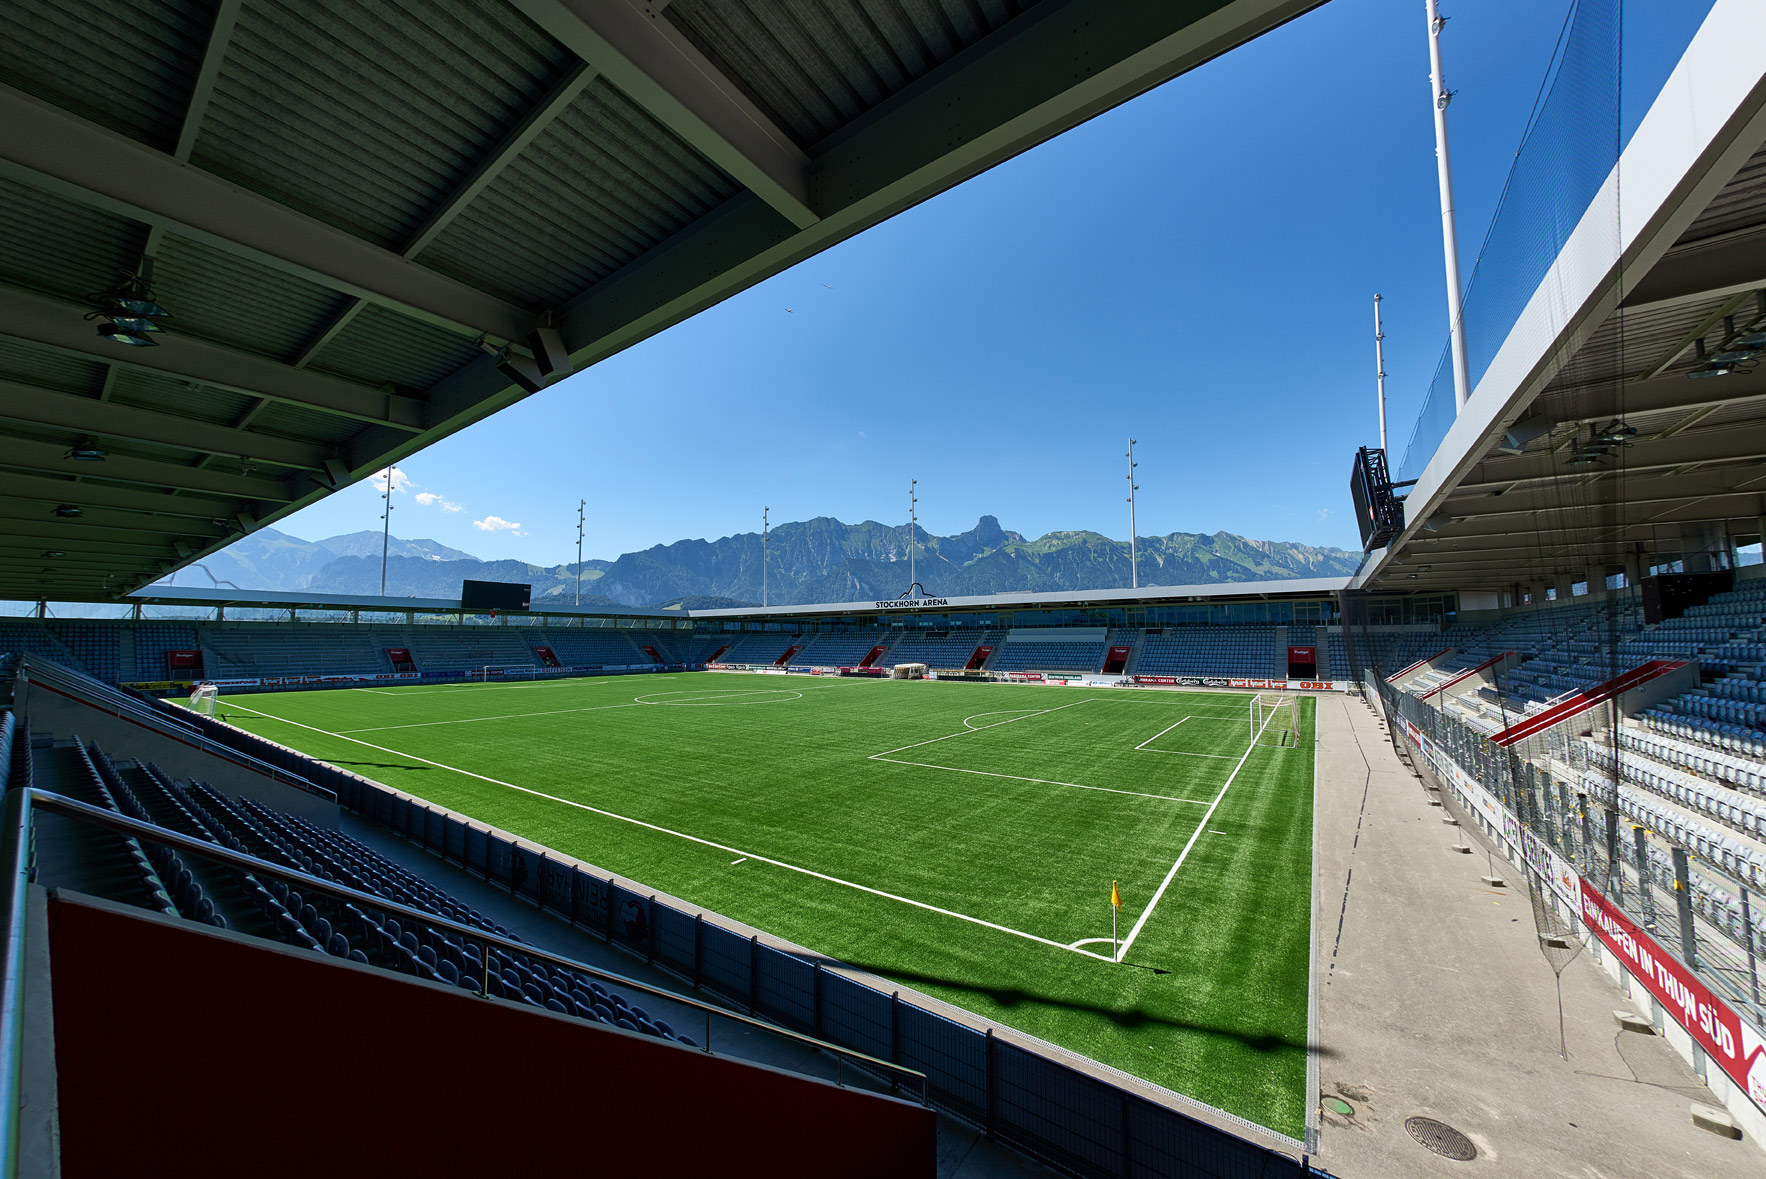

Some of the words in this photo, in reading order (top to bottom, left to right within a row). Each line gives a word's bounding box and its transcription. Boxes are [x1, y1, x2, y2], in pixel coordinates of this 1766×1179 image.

[875, 600, 920, 609] STOCKHORN
[922, 598, 948, 607] ARENA
[1175, 676, 1200, 685] Carlsberg
[1202, 677, 1228, 686] Carlsberg
[1299, 681, 1334, 690] OBI
[1582, 892, 1639, 964] EINKAUFEN
[1638, 945, 1655, 980] IN
[1653, 958, 1698, 1023] THUN
[1698, 1001, 1736, 1060] SÜD
